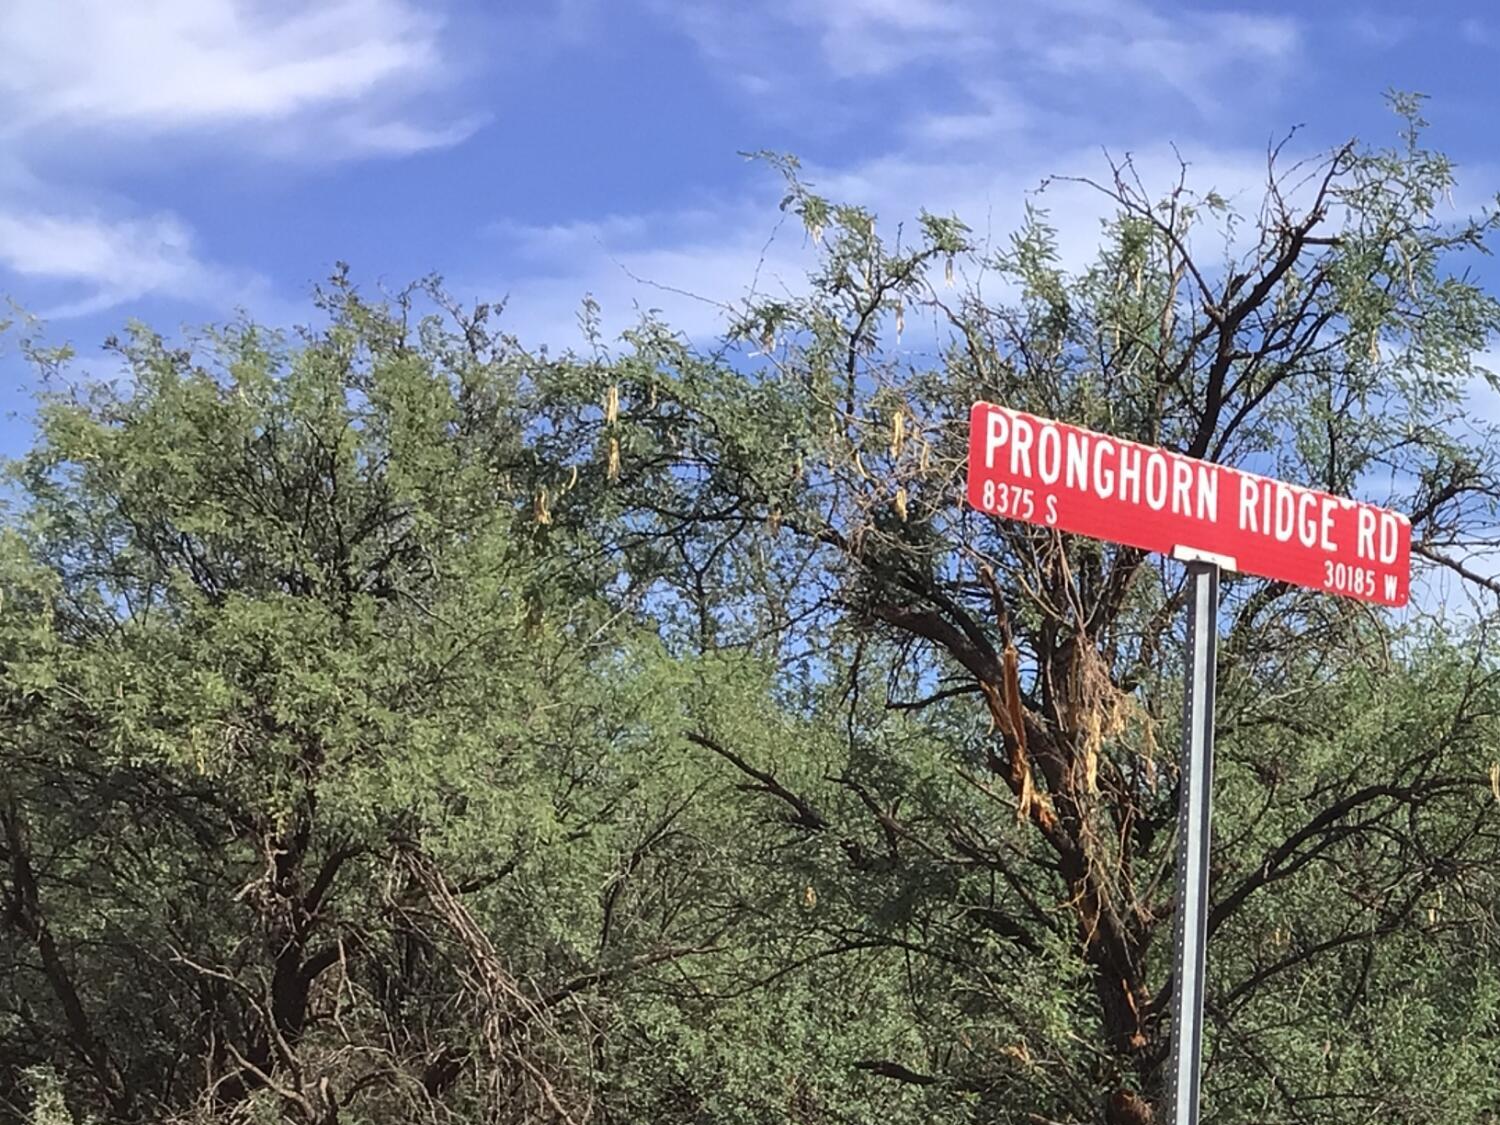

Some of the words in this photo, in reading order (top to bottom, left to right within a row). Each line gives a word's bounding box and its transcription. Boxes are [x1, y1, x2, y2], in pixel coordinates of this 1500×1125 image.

[982, 478, 1035, 520] 8375
[1046, 494, 1058, 525] S
[985, 412, 1218, 522] PRONGHORN
[1239, 479, 1338, 551] RIDGE
[1357, 503, 1398, 564] RD
[1324, 560, 1376, 597] 30185
[1384, 574, 1398, 601] W
